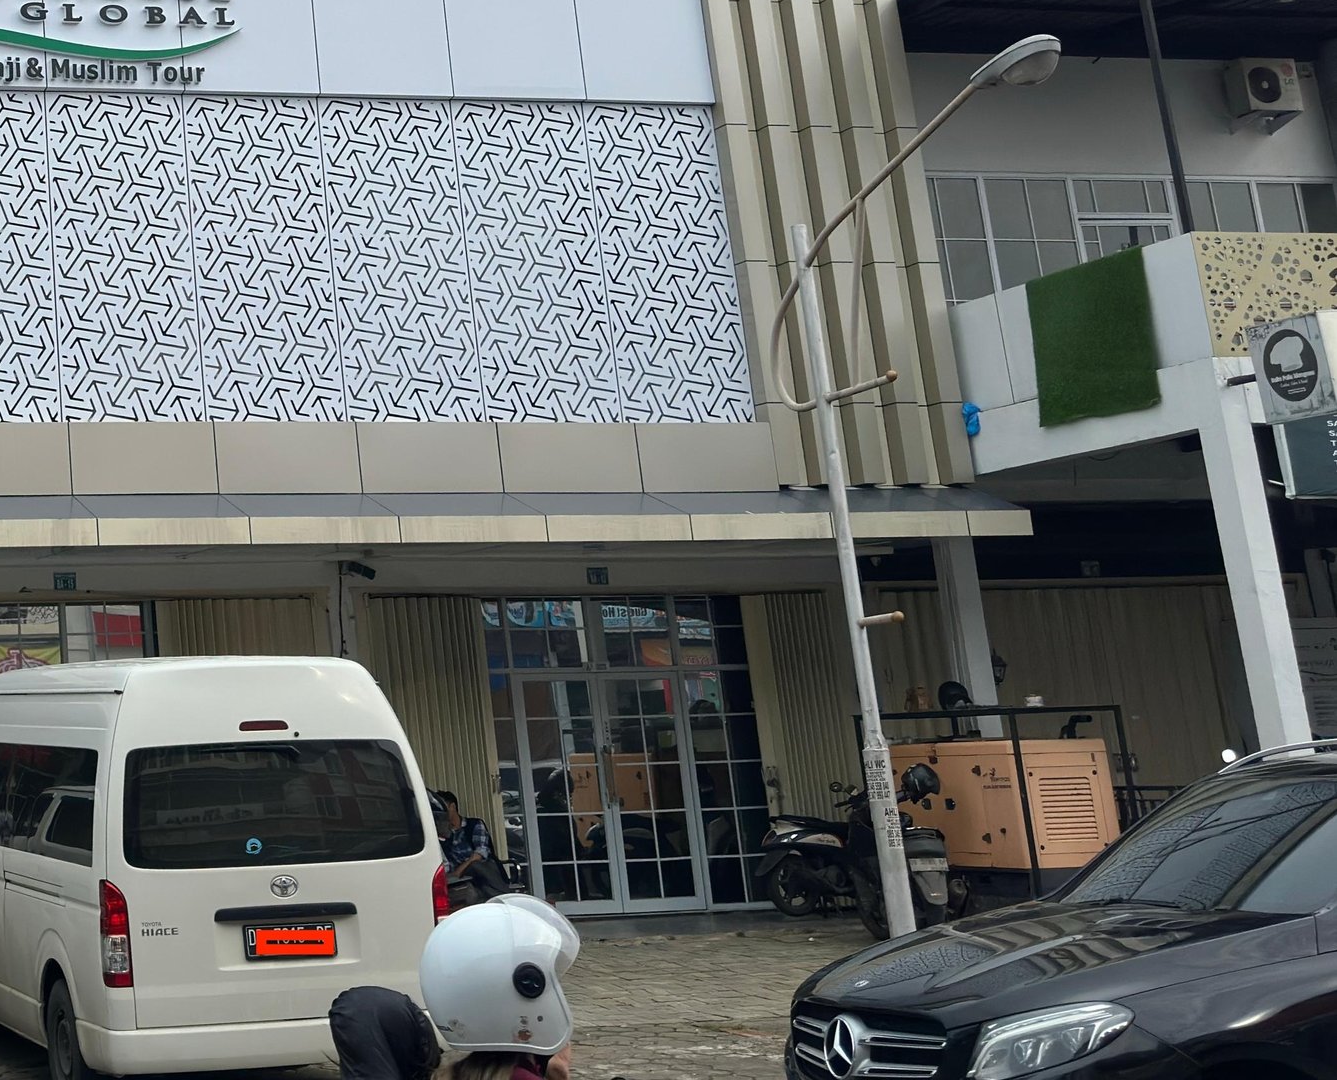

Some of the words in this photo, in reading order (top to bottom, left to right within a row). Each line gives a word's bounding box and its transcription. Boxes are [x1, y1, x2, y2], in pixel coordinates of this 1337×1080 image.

[19, 1, 236, 27] GLOBAL
[26, 58, 44, 80] &
[50, 57, 138, 83] Muslim
[146, 60, 206, 85] Tour
[875, 759, 886, 769] WC
[141, 927, 179, 937] HIACE
